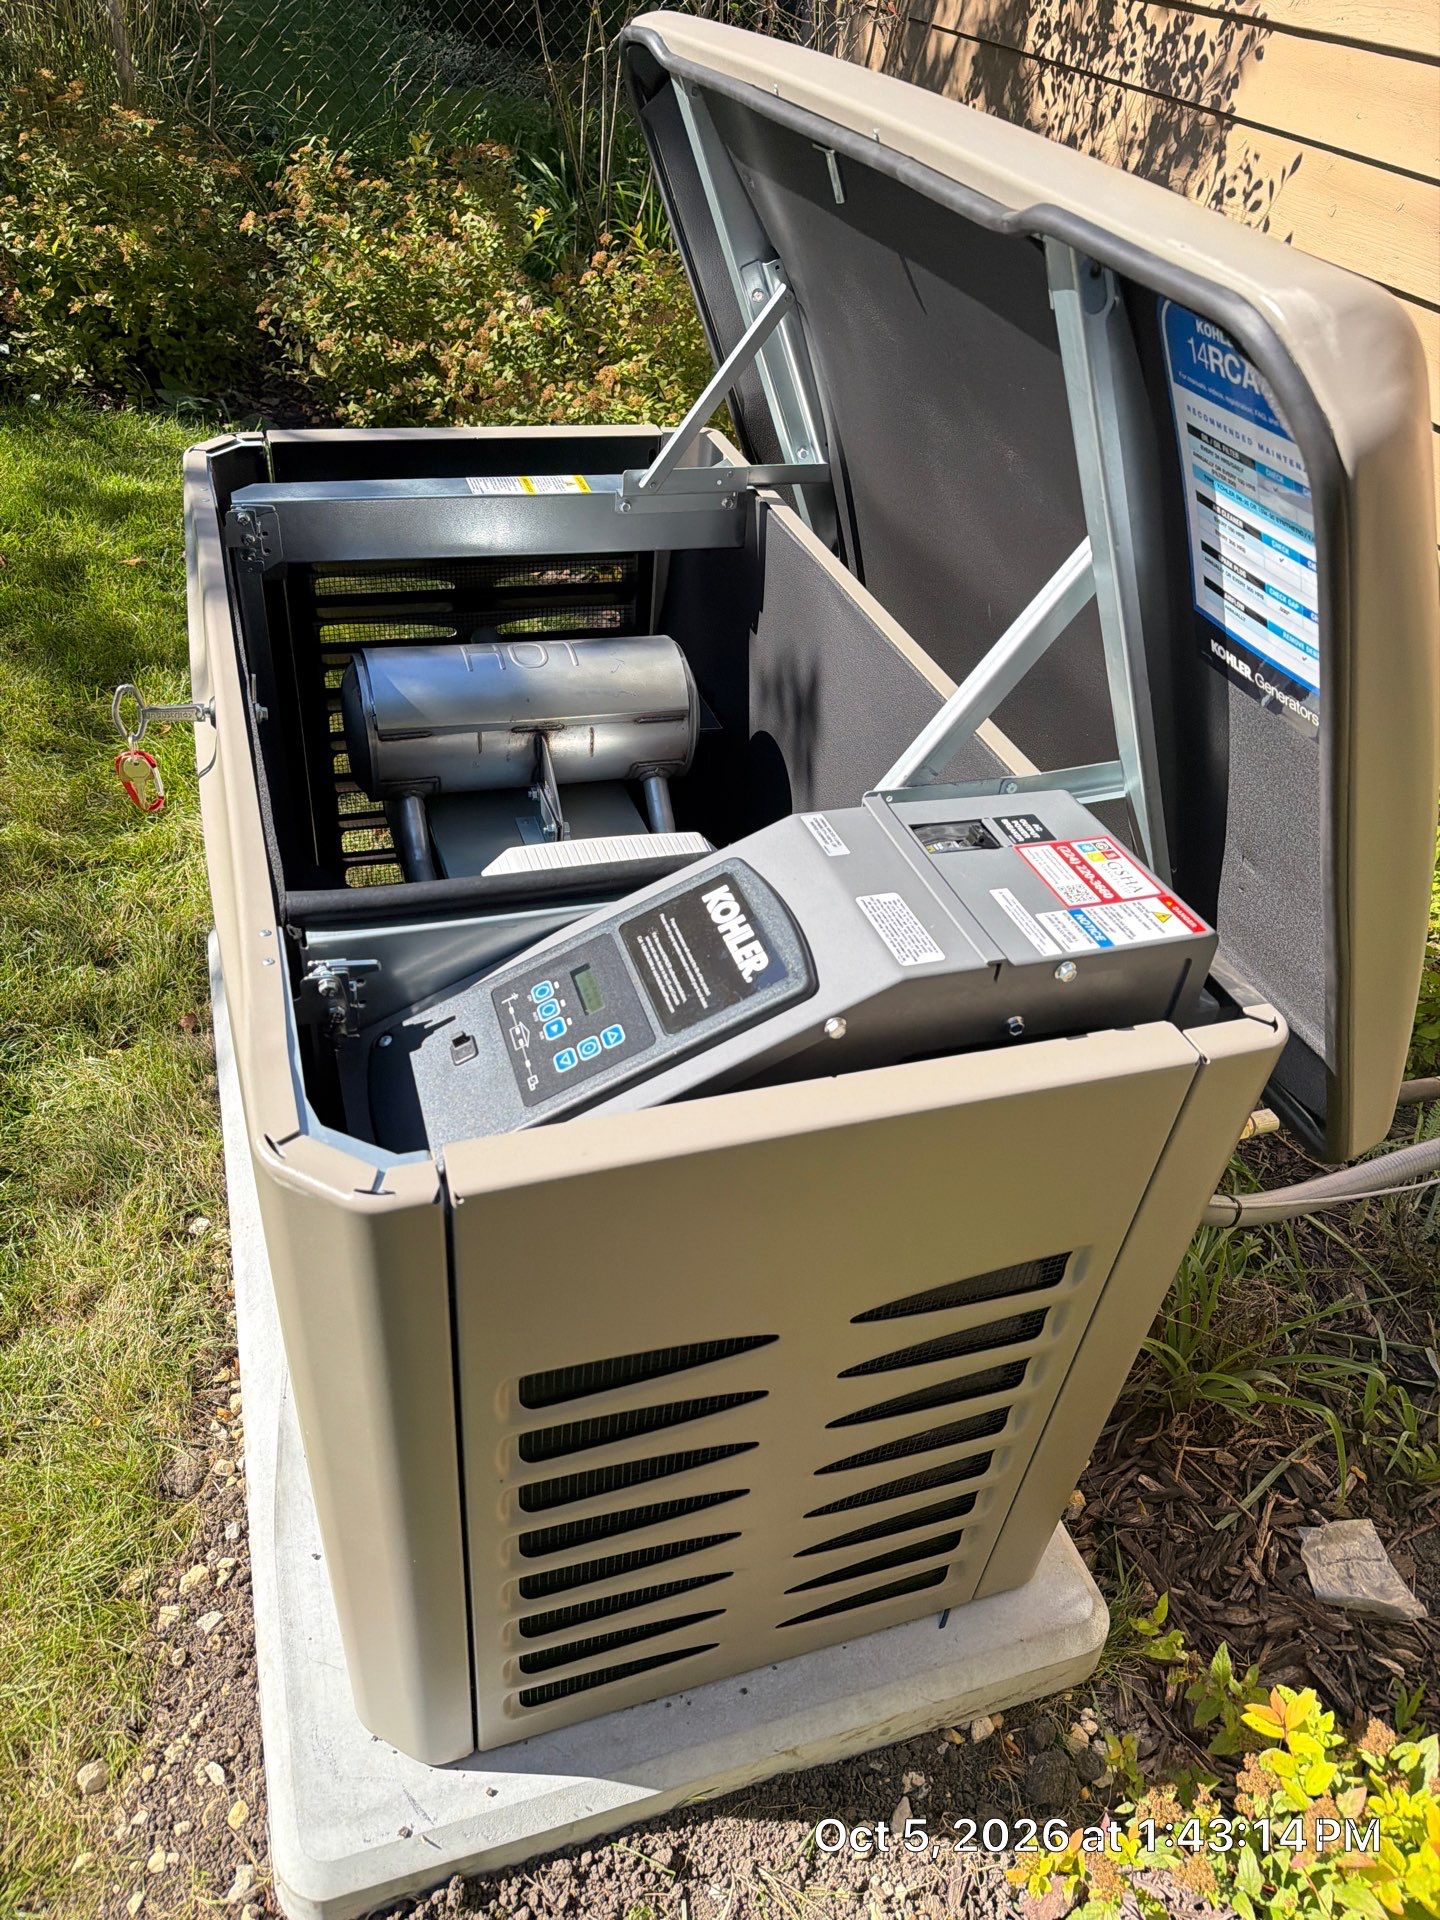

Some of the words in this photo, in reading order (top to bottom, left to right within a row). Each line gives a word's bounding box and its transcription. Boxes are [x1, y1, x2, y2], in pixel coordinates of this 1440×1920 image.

[1195, 319, 1234, 349] KOHL
[1187, 405, 1253, 446] RECOMMENDED
[1257, 442, 1306, 472] MAINTEN
[458, 639, 584, 673] HOT
[1254, 672, 1320, 727] Generators
[1107, 861, 1143, 893] GSHA
[1073, 914, 1107, 942] NOTICE
[1171, 905, 1198, 928] DANGER
